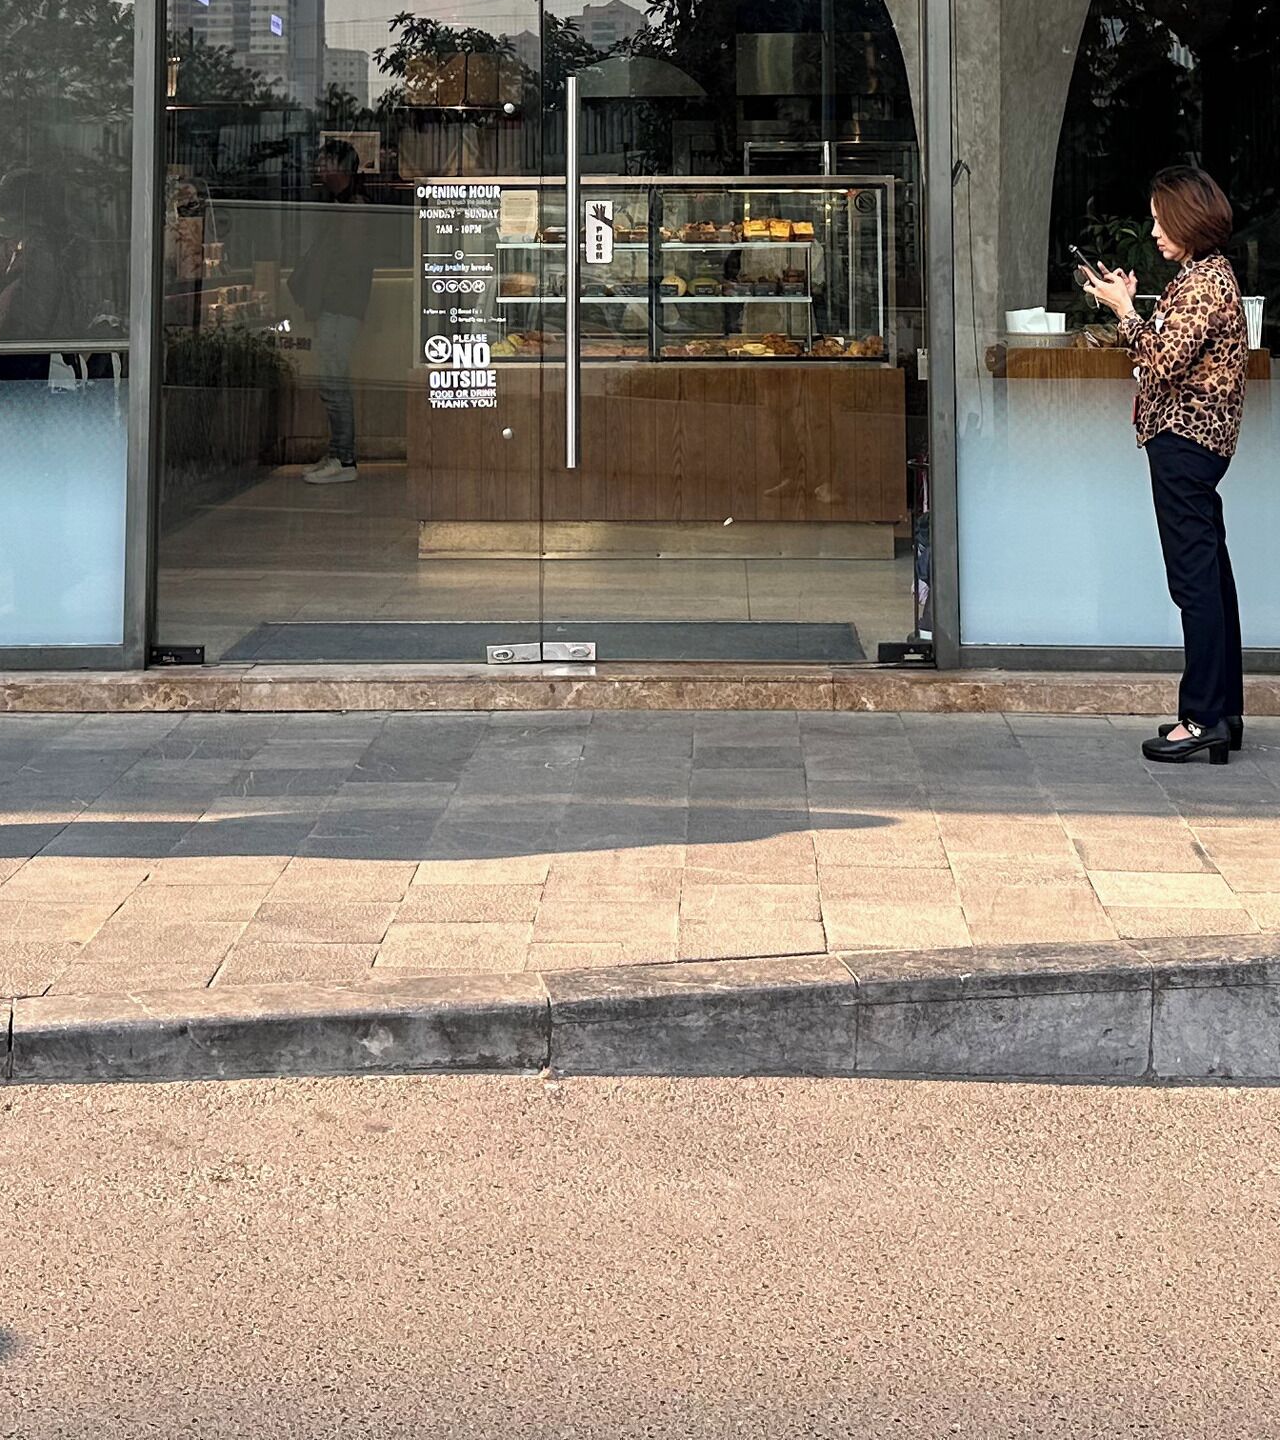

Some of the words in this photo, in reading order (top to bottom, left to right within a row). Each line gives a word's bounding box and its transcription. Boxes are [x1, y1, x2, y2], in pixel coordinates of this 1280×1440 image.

[417, 186, 466, 198] OPENING
[469, 185, 501, 198] HOUR
[419, 209, 455, 218] MONDAY
[464, 209, 499, 218] SUNDAY
[435, 224, 453, 234] 7AM
[461, 224, 482, 234] 10PM
[452, 334, 487, 342] PLEASE
[452, 342, 490, 368] NO
[429, 370, 497, 388] OUTSIDE
[430, 390, 454, 398] FOOD
[455, 389, 469, 397] OR
[470, 389, 496, 397] DRINK
[430, 400, 469, 408] THANK
